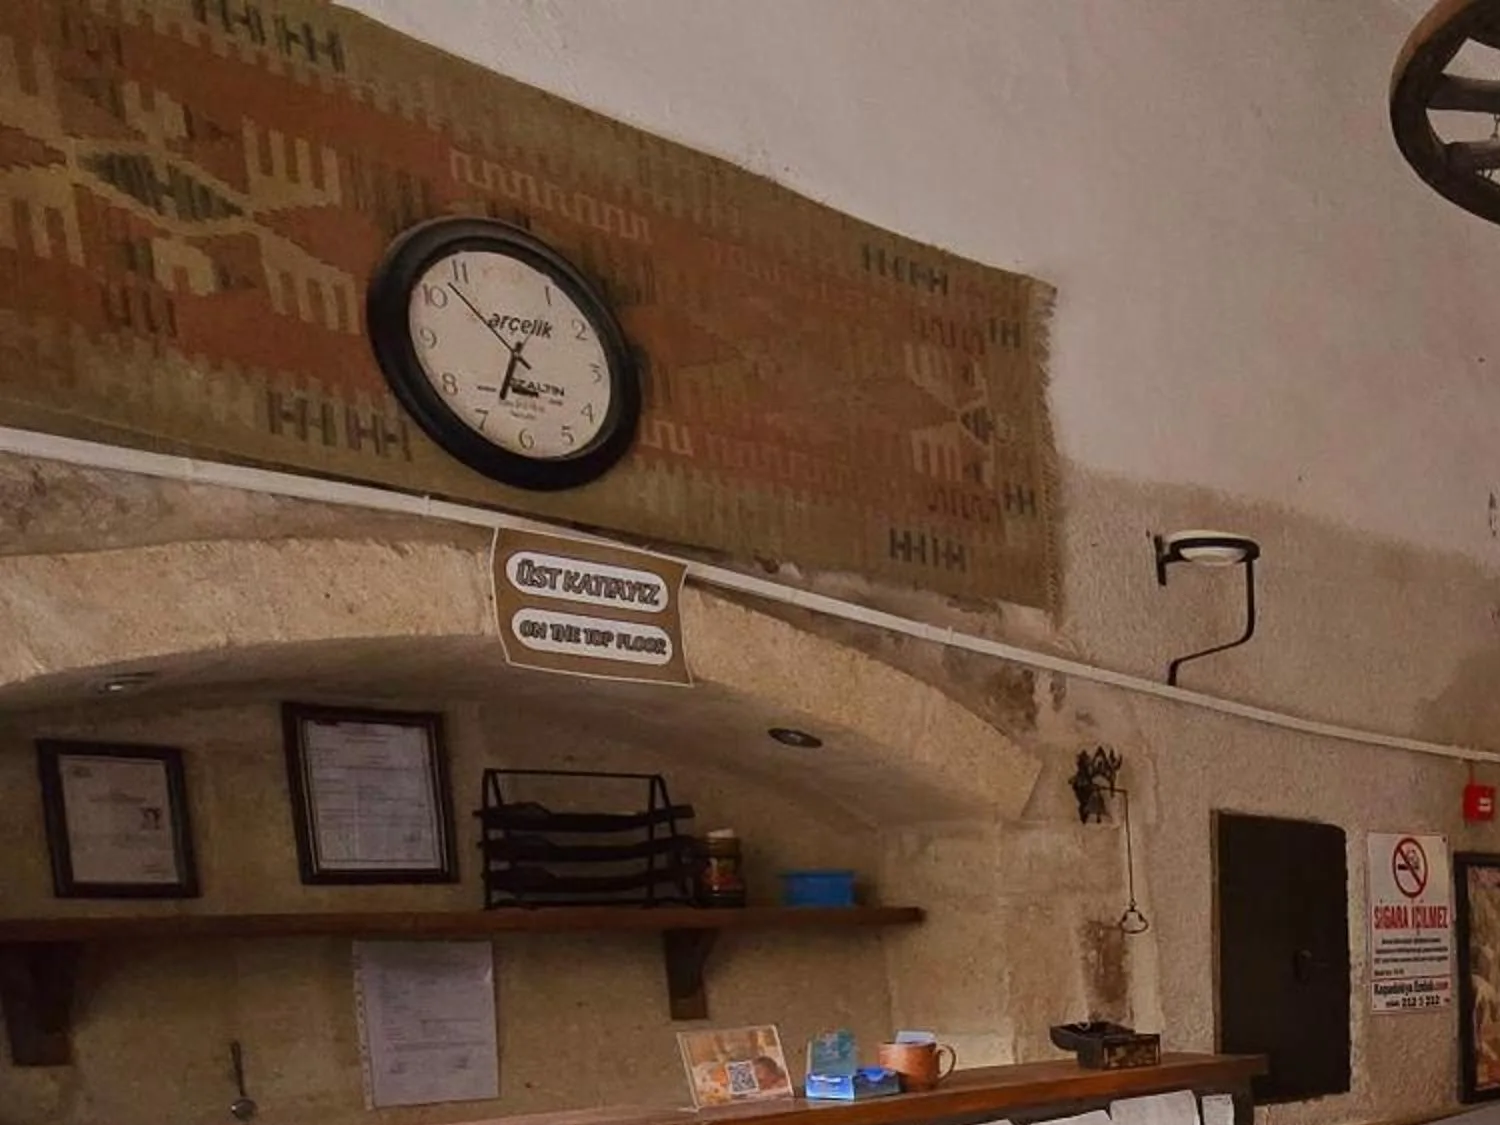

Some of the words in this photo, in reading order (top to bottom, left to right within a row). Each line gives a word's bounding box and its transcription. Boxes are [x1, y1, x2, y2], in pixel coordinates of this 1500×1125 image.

[451, 259, 470, 284] 11
[422, 282, 449, 309] 10
[544, 285, 553, 307] 1
[488, 312, 553, 340] arçelik
[571, 319, 588, 342] 2
[419, 327, 438, 349] 9
[440, 373, 459, 397] 8
[588, 362, 603, 385] 3
[475, 408, 489, 431] 7
[580, 402, 595, 424] 4
[518, 427, 536, 450] 6
[560, 424, 575, 446] 5
[519, 619, 548, 640] ON
[549, 623, 581, 644] THE
[583, 626, 615, 649] TOP
[615, 633, 667, 655] FLOOR
